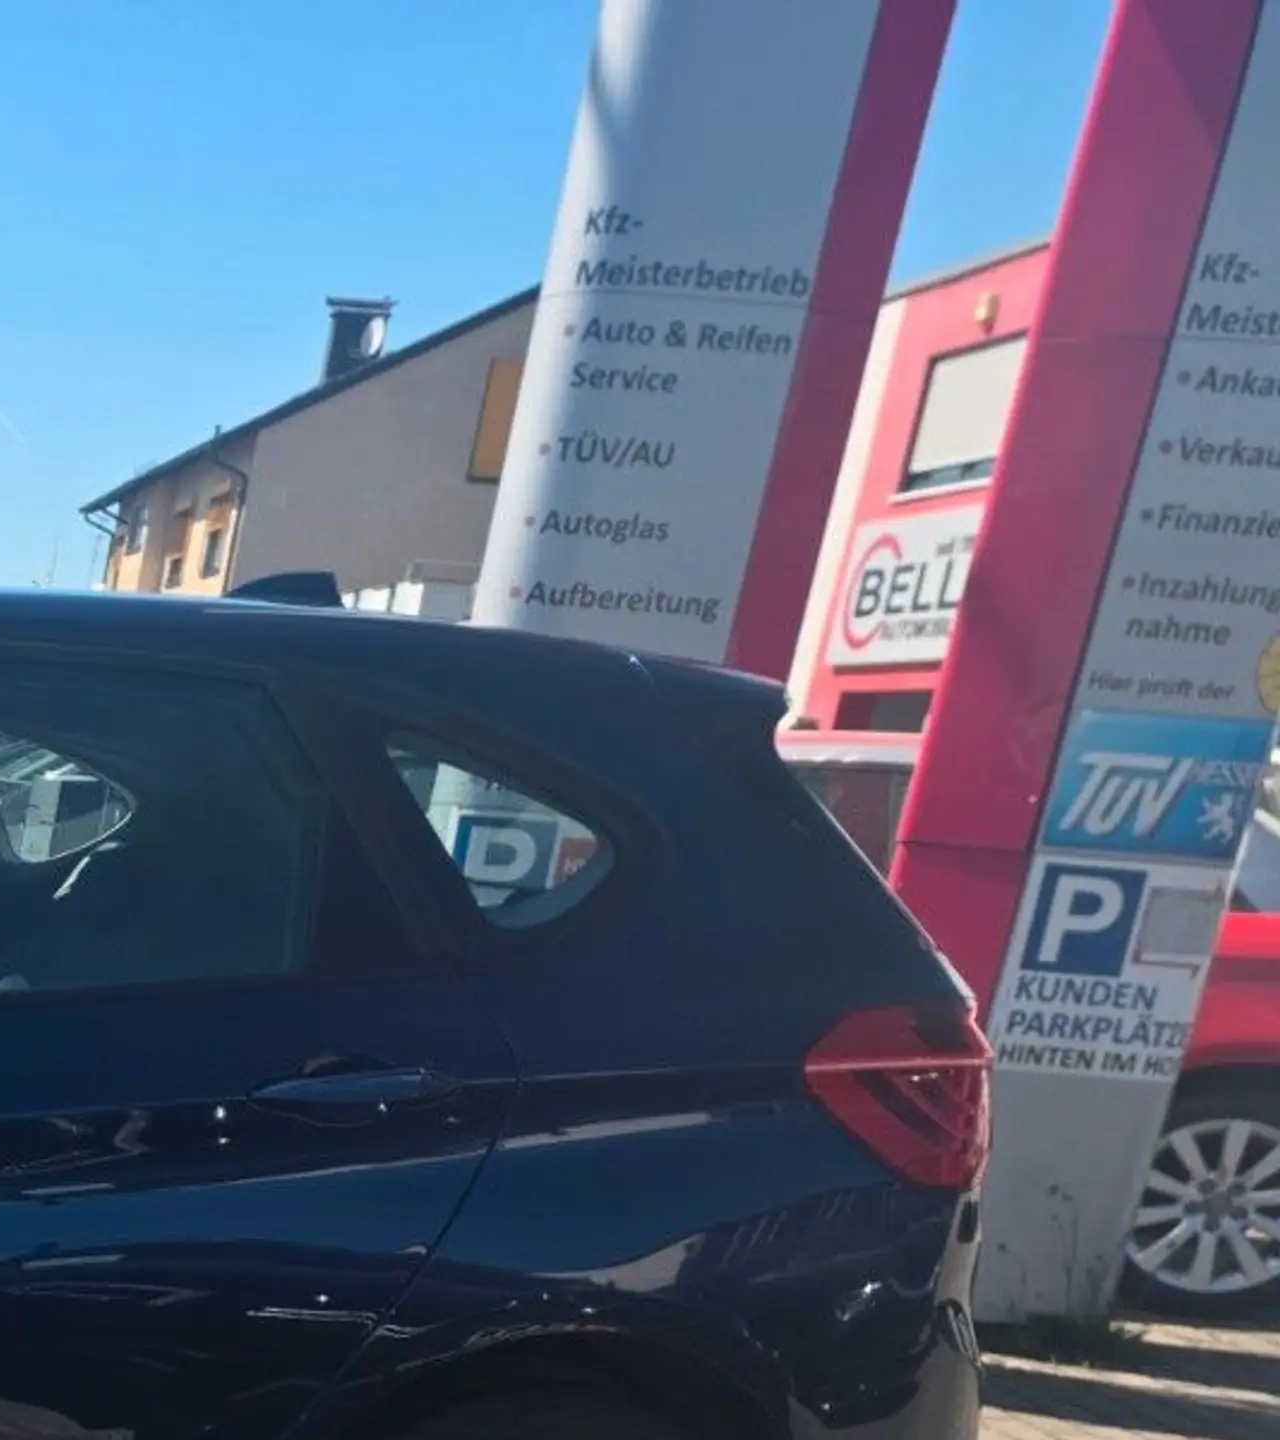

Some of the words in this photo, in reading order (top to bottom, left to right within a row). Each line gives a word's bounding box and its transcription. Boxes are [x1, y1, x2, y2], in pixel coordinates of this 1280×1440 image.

[584, 205, 644, 235] Kfz-
[576, 253, 811, 298] Meisterbetrieb
[1200, 253, 1260, 285] Kfz-
[581, 316, 656, 347] Auto
[664, 318, 687, 349] &
[697, 322, 794, 356] Reifen
[569, 361, 679, 394] Service
[558, 430, 676, 468] TÜV/AU
[540, 509, 671, 545] Autoglas
[525, 581, 720, 624] Aufbereitung
[1125, 614, 1233, 646] nahme
[1039, 873, 1125, 963] P
[1015, 974, 1158, 1011] KUNDEN
[998, 1042, 1093, 1070] HINTEN
[1100, 1050, 1138, 1074] IM
